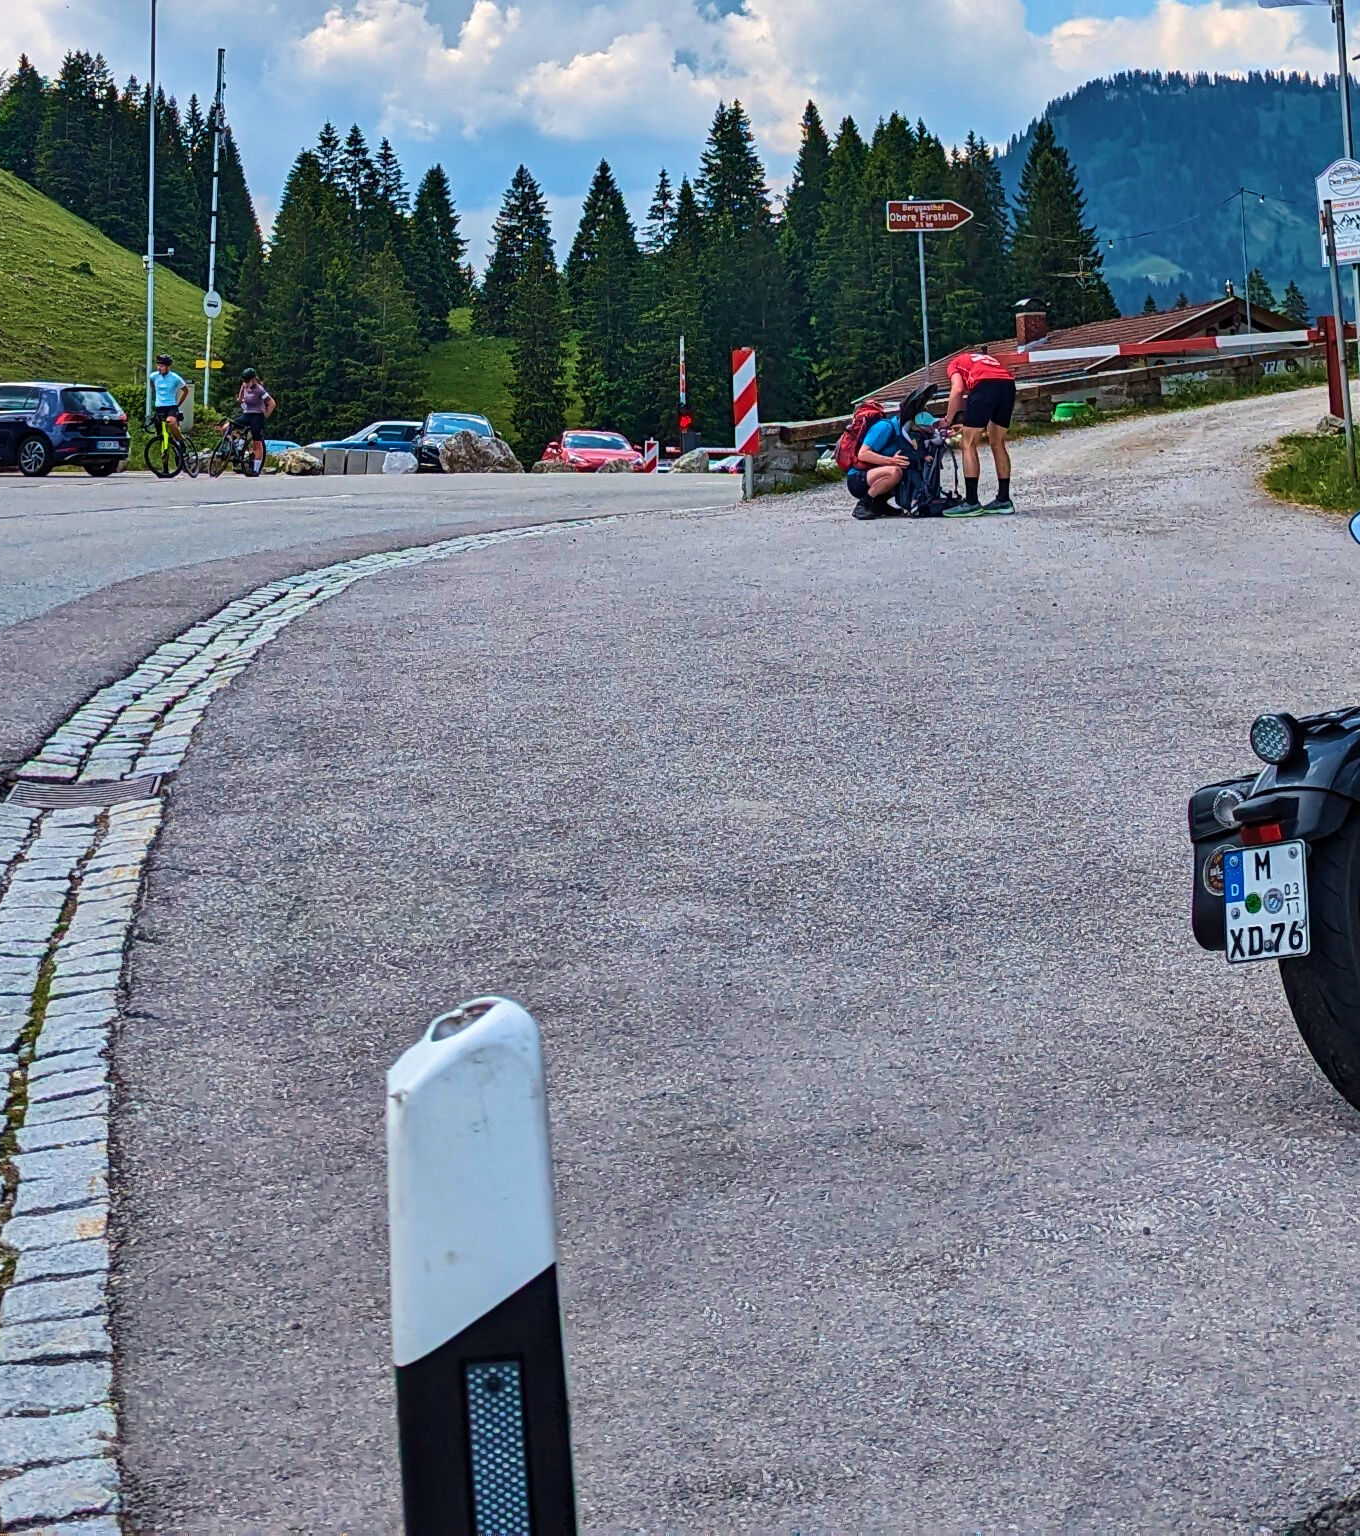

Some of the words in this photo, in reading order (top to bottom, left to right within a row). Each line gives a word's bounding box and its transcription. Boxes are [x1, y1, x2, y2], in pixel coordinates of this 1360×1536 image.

[890, 213, 917, 222] Obere
[920, 212, 959, 221] Firstalm
[1255, 850, 1271, 881] M
[1231, 884, 1239, 896] D
[1284, 882, 1299, 895] 03
[1286, 902, 1300, 915] 11
